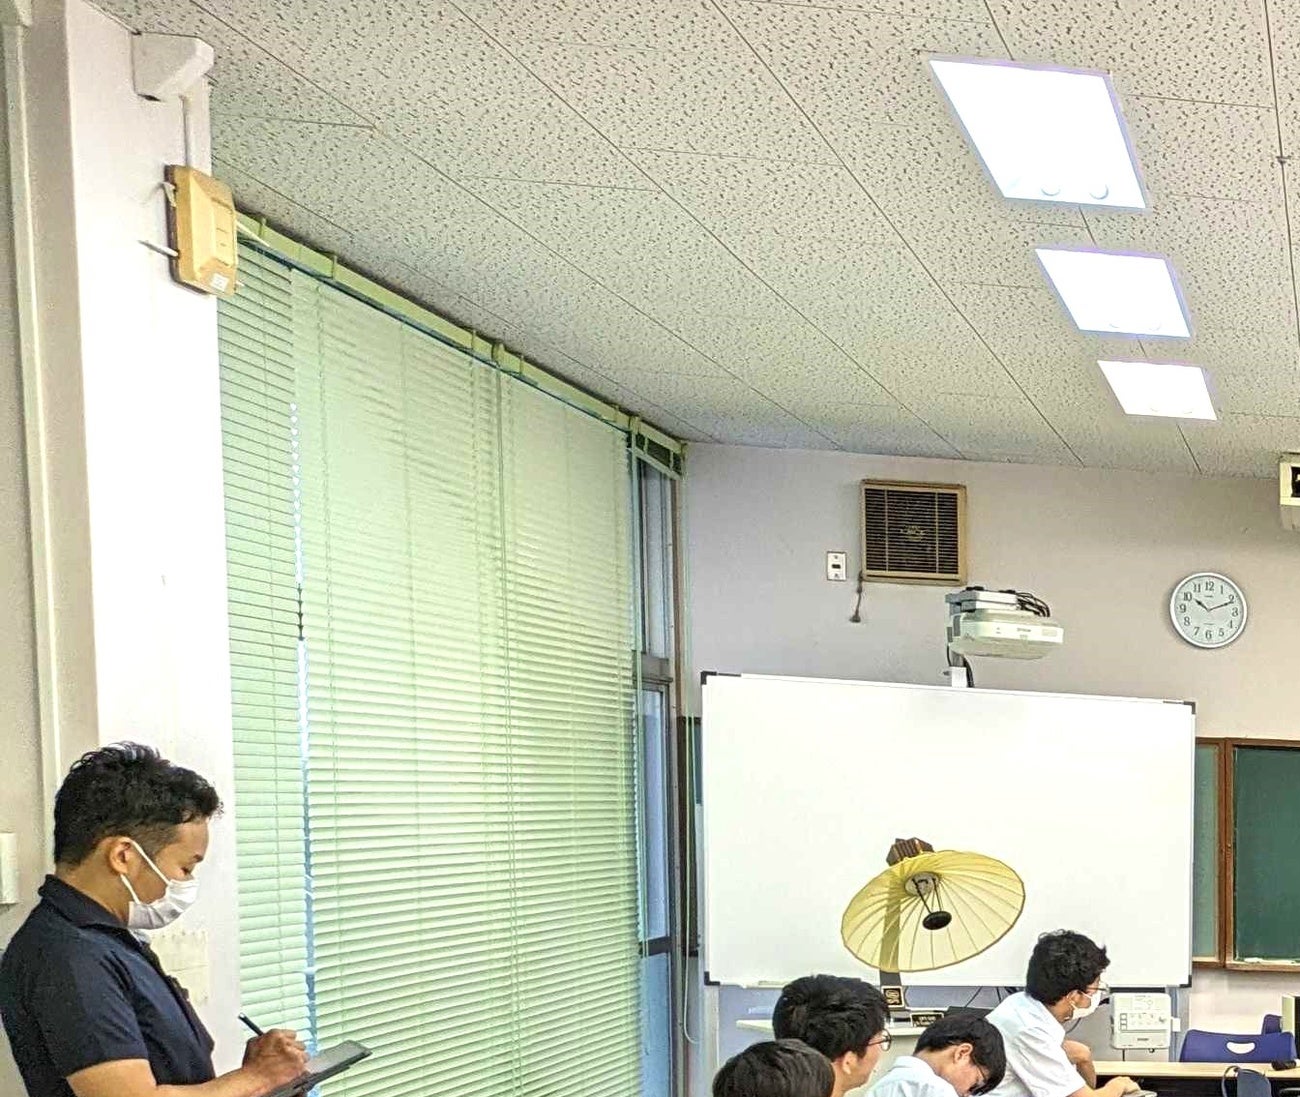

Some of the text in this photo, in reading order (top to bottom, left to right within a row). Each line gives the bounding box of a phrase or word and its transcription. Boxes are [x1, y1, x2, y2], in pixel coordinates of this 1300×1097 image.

[1193, 583, 1201, 593] 11
[1205, 580, 1214, 591] 12
[1220, 585, 1224, 595] 1
[1183, 592, 1192, 602] 10
[1179, 603, 1186, 613] 9
[1231, 607, 1239, 617] 3
[1183, 616, 1190, 626] 8
[1194, 626, 1200, 636] 7
[1205, 630, 1212, 640] 6
[1218, 627, 1225, 637] 5
